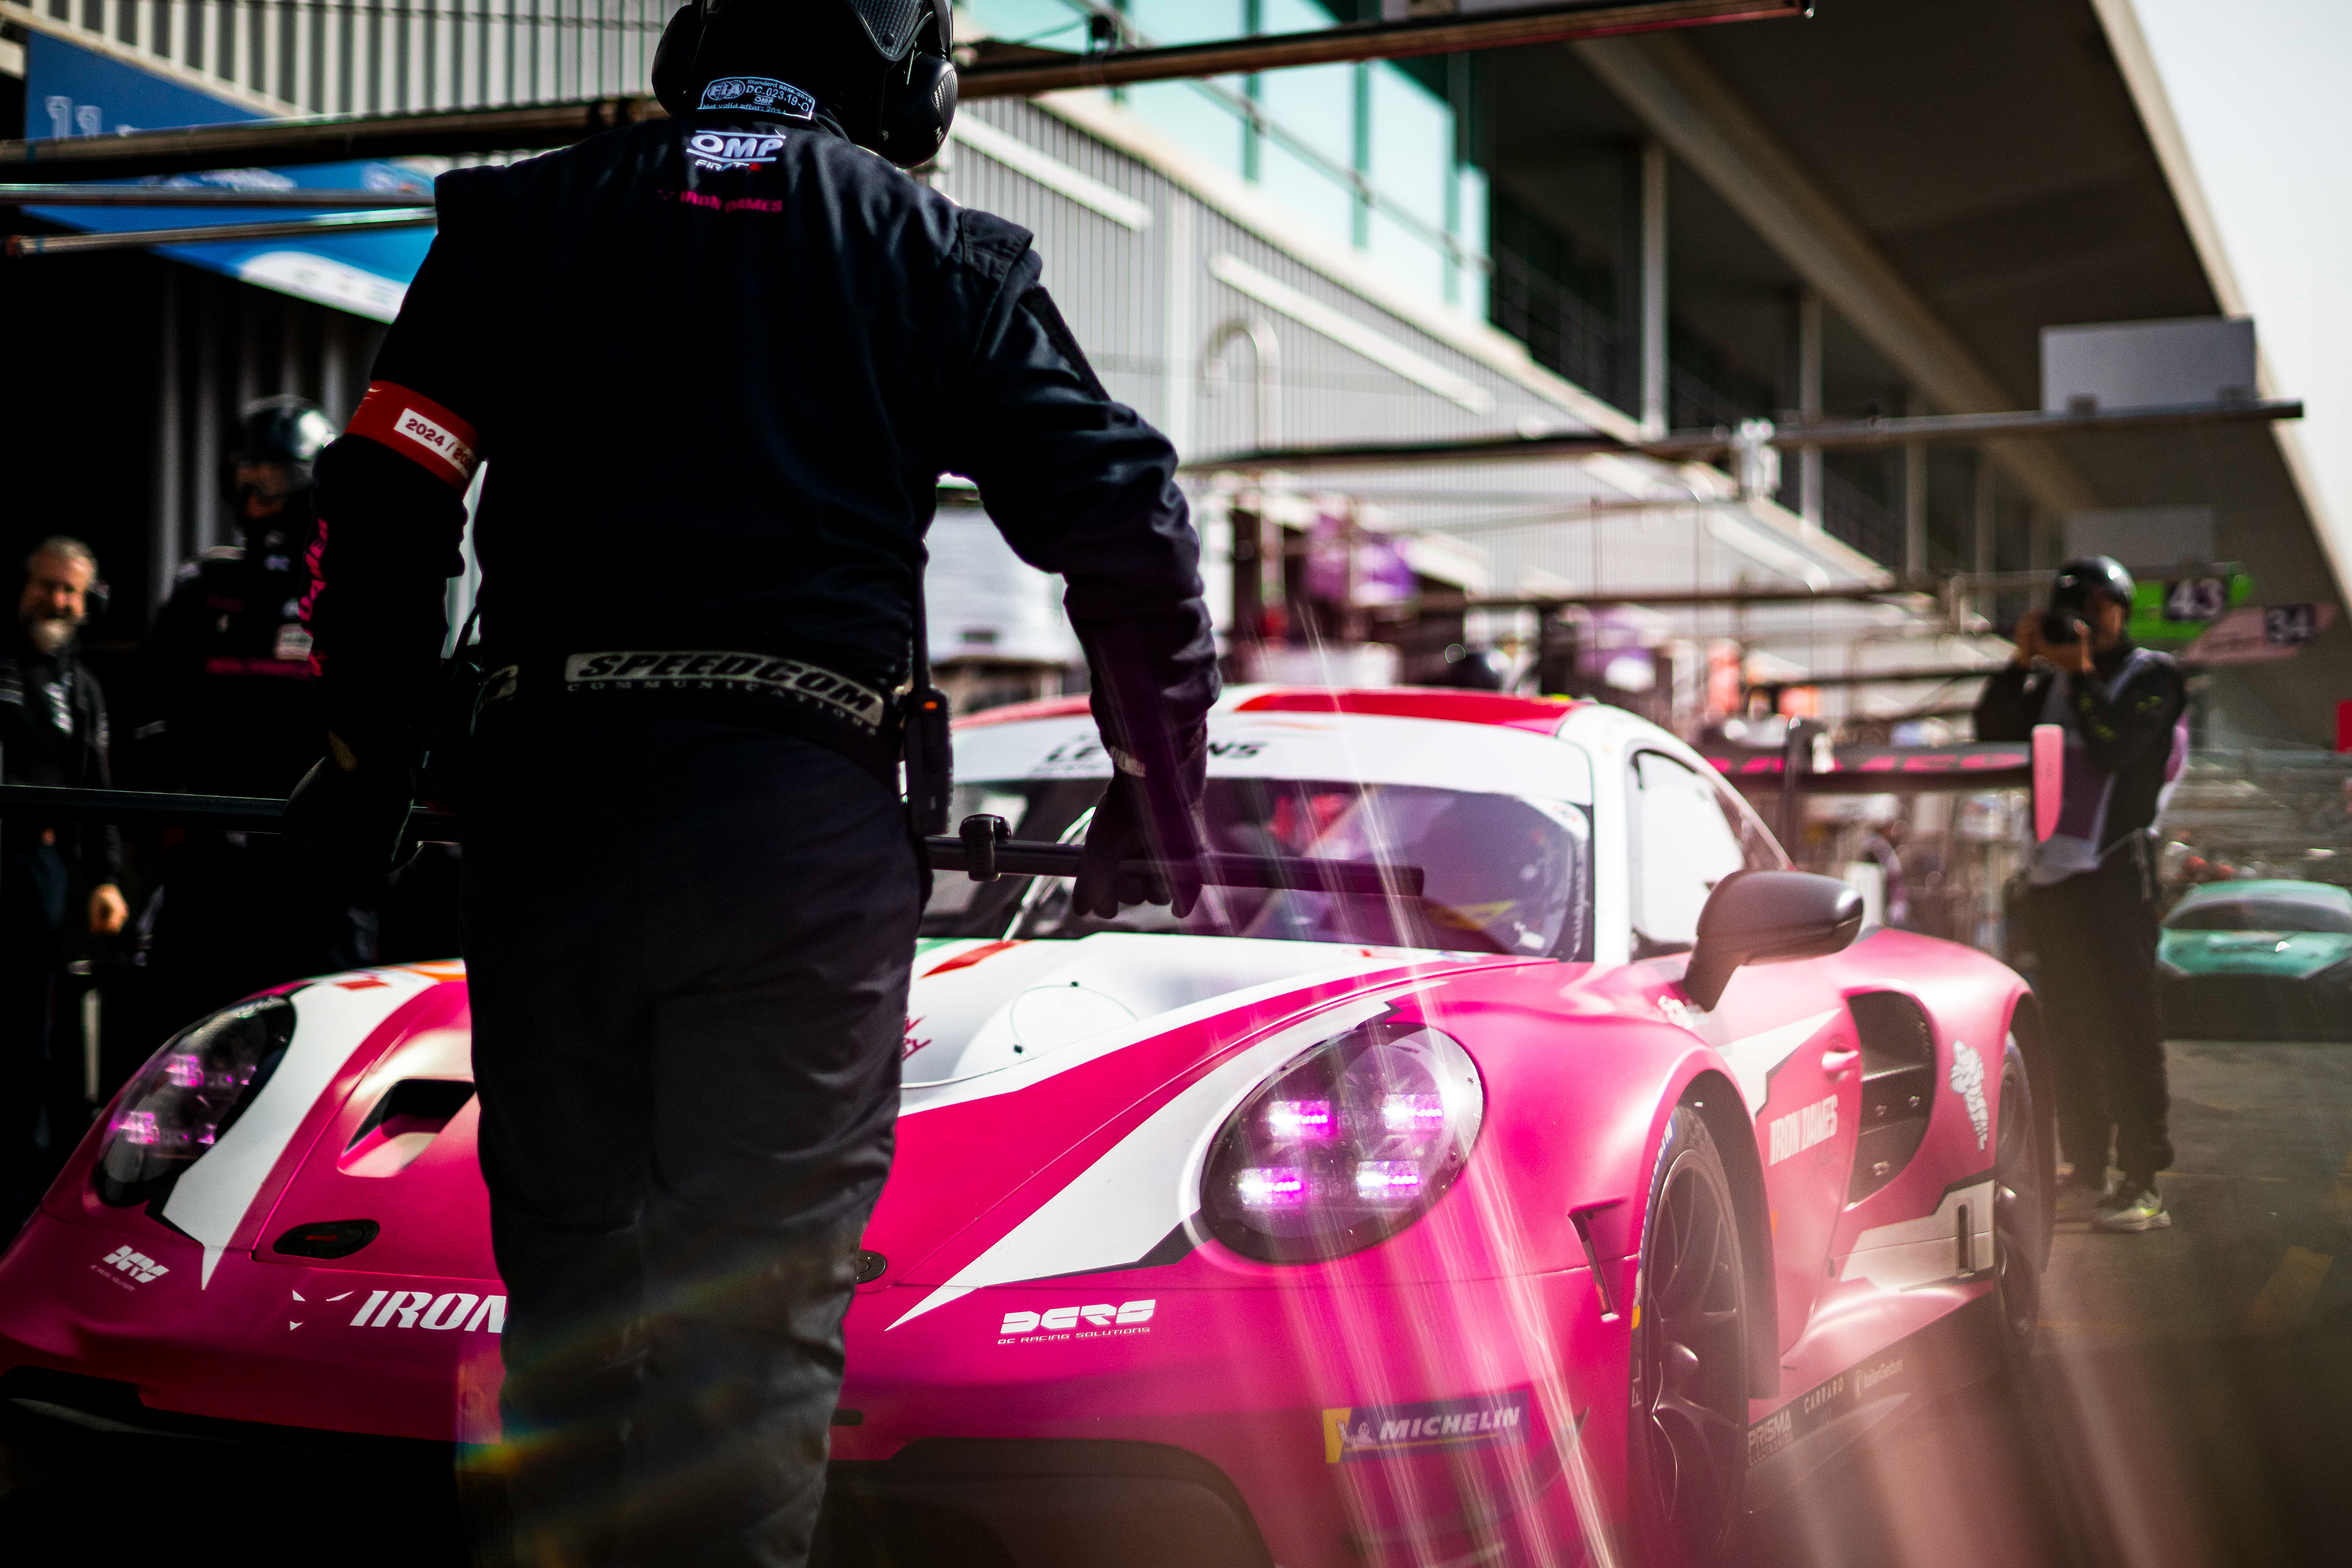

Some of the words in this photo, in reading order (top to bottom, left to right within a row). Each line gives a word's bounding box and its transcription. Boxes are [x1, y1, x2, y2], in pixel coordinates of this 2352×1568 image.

[709, 83, 741, 96] FIA
[747, 79, 778, 88] Standard
[754, 96, 774, 105] OMP
[691, 134, 783, 158] OMP
[405, 418, 445, 447] 2024
[2169, 578, 2223, 615] 43
[2267, 608, 2308, 640] 34
[578, 654, 876, 711] SPEEDCOM
[1769, 1112, 1800, 1166] IRON
[1801, 1093, 1838, 1151] DAMES
[349, 1290, 507, 1333] IRON
[1020, 1333, 1070, 1343] RACING
[1075, 1326, 1151, 1338] SOLUTIONS
[1379, 1406, 1519, 1441] MICHELIN
